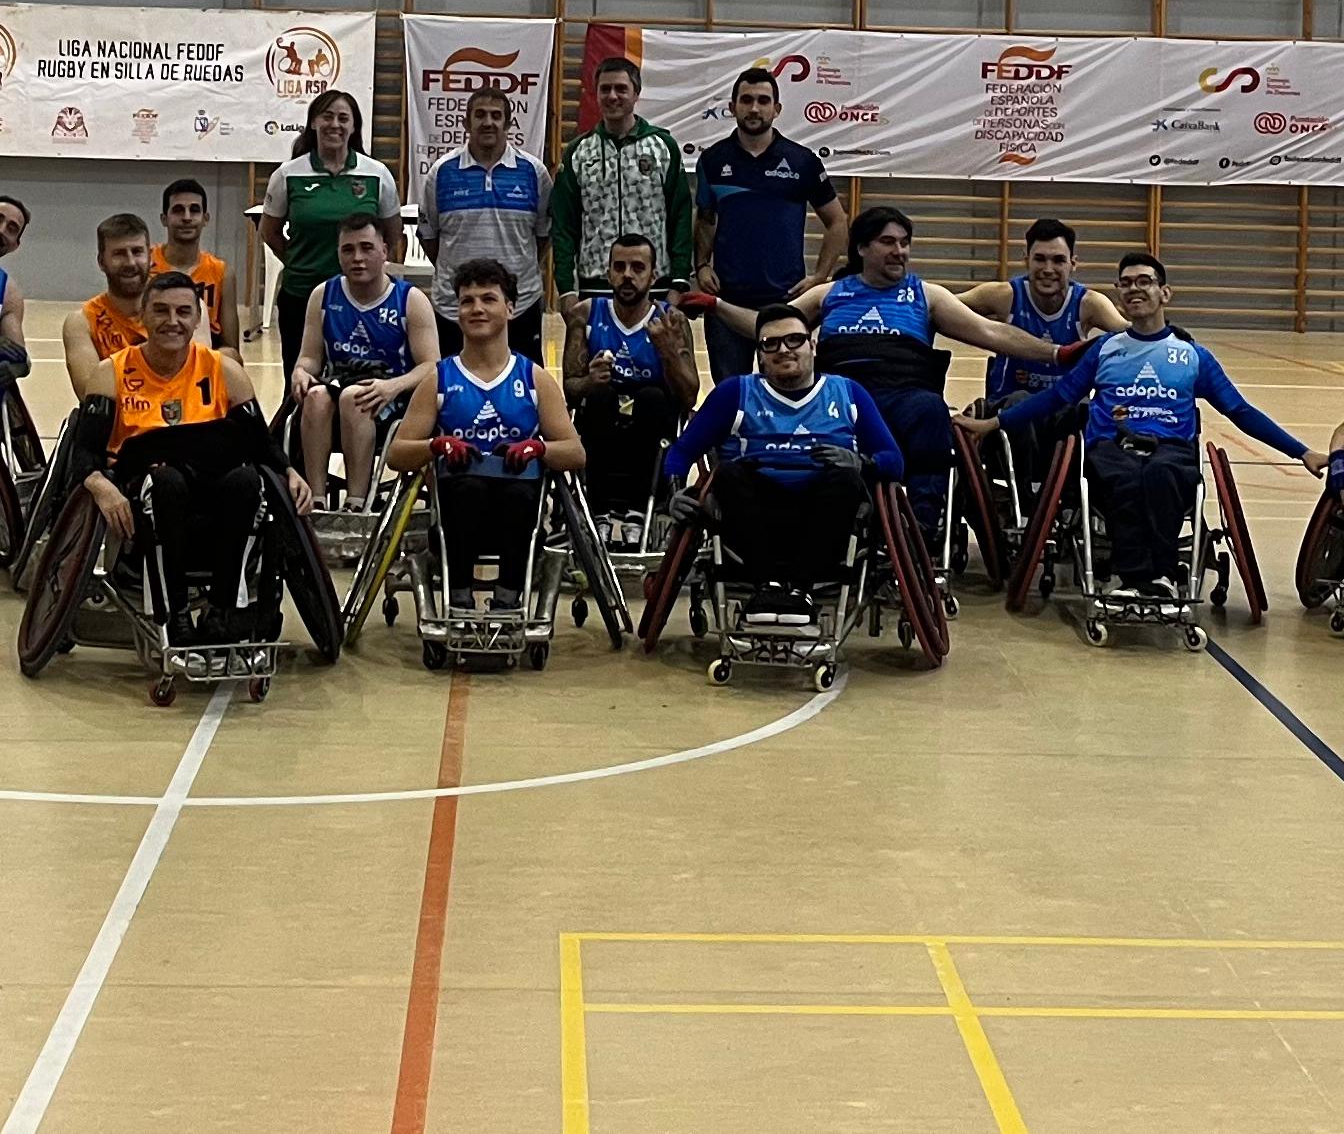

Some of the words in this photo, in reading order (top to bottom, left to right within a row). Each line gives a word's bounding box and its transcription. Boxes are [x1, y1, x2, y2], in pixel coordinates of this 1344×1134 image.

[58, 39, 92, 57] LIGA
[97, 40, 172, 61] NACIONAL
[176, 42, 225, 61] FEDDF
[37, 59, 86, 79] RUGBY
[90, 61, 110, 79] EN
[114, 62, 154, 80] SILLA
[160, 63, 180, 81] DE
[183, 64, 244, 82] RUEDAS
[981, 62, 1073, 80] FEDDF
[277, 79, 303, 95] LIGA
[305, 80, 328, 95] RSR
[421, 69, 540, 95] FEDDF
[839, 112, 879, 122] ONCE
[994, 106, 1058, 118] DEPORTES
[982, 118, 1049, 130] PERSONAS
[974, 129, 1065, 143] DISCAPACIDAD
[1167, 346, 1190, 366] 34
[195, 376, 212, 406] 1
[513, 378, 525, 398] 9
[1115, 383, 1178, 401] adapta
[827, 400, 840, 419] 4
[452, 423, 521, 443] adapta
